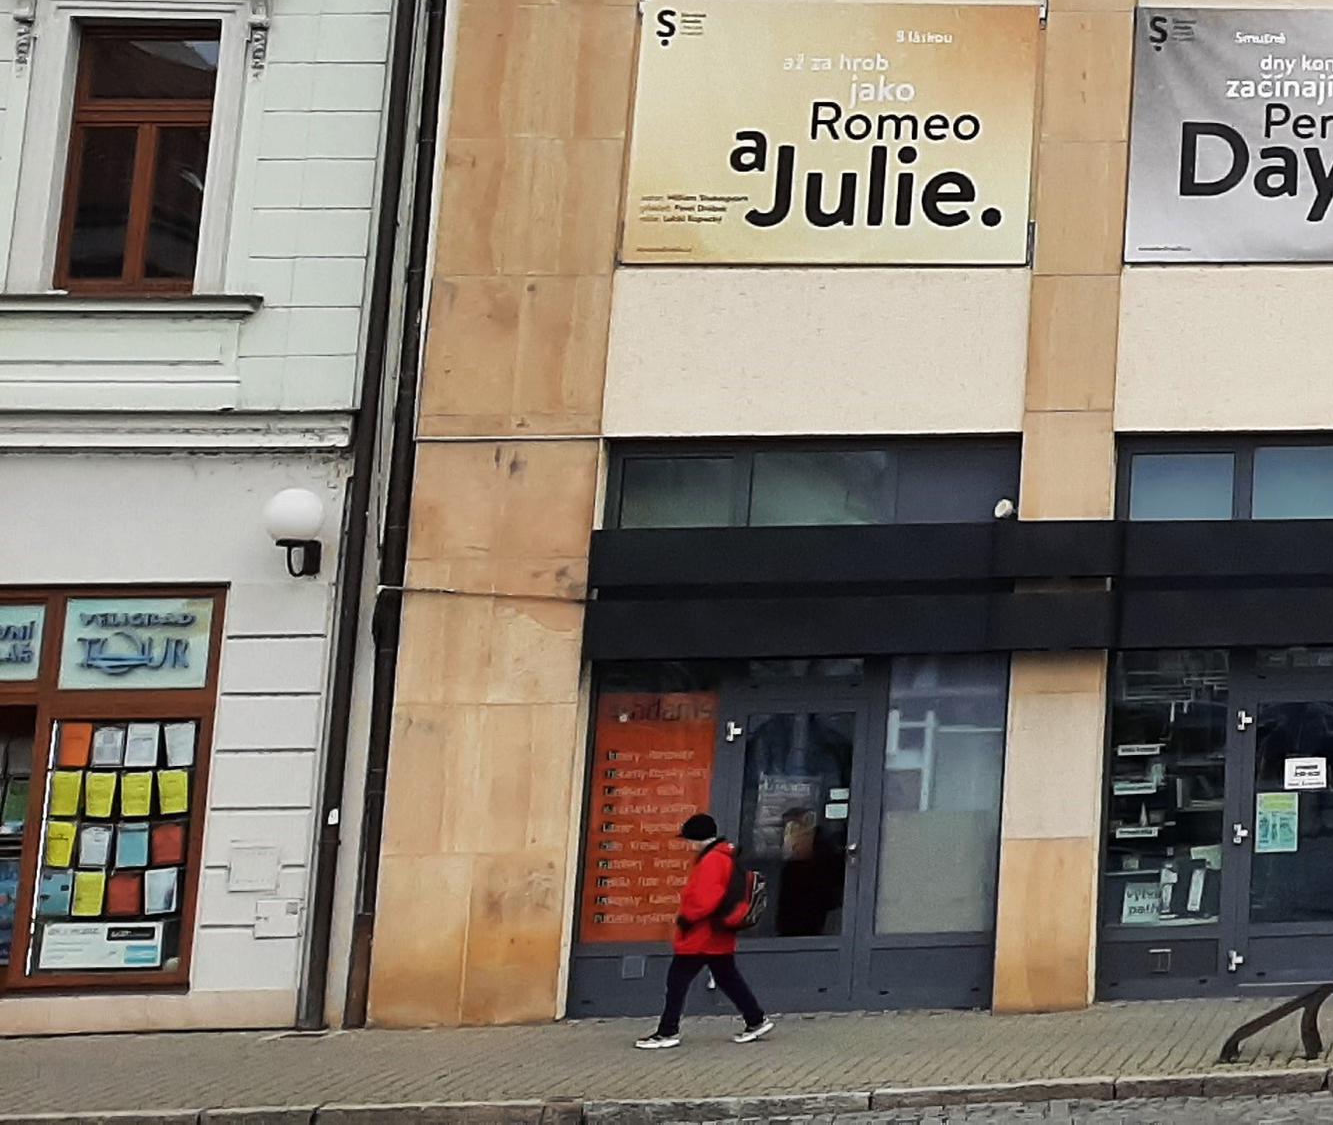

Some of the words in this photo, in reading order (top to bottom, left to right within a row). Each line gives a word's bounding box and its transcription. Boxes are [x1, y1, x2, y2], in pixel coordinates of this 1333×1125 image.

[811, 57, 832, 71] za
[840, 53, 889, 72] hrob
[1260, 54, 1297, 75] dny
[849, 75, 915, 109] jako
[810, 101, 981, 141] Romeo
[729, 129, 768, 173] a
[745, 145, 1003, 228] Julie.
[76, 627, 190, 675] TOUR
